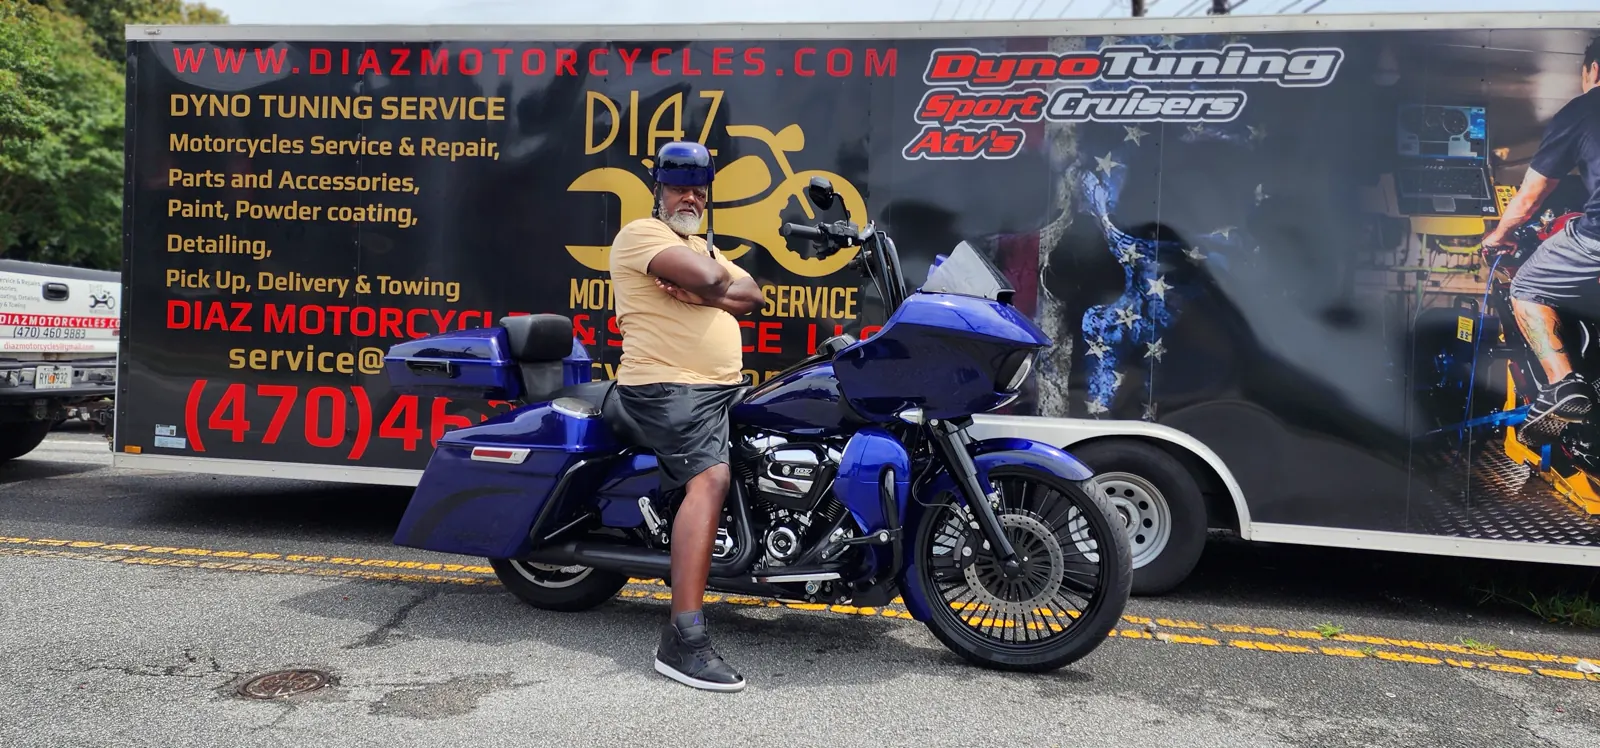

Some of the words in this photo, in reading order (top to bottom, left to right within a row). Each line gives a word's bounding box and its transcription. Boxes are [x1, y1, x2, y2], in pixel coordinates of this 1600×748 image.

[173, 47, 898, 77] WWW.DIAZMOTORCYCLES.COM
[170, 94, 251, 117] DYNO
[259, 95, 373, 119] TUNING
[381, 97, 505, 121] SERVICE
[921, 93, 1044, 122] Sport
[1050, 92, 1239, 116] Cruisers
[585, 90, 724, 157] DIAZ
[169, 133, 304, 158] Motorcycles
[310, 135, 393, 156] Service
[398, 136, 415, 156] &
[421, 137, 500, 161] Repair,
[910, 131, 1019, 154] Atv's
[168, 168, 225, 188] Parts
[231, 169, 273, 189] and
[278, 170, 420, 195] Accessories,
[168, 199, 229, 220] Paint,
[236, 200, 321, 221] Powder
[327, 203, 418, 228] coating,
[167, 234, 272, 260] Detailing,
[166, 269, 210, 289] Pick
[215, 270, 251, 294] Up,
[258, 272, 350, 298] Delivery
[355, 274, 372, 294] &
[377, 275, 460, 302] Towing
[760, 284, 858, 320] SERVICE
[13, 326, 40, 339] (470)
[43, 328, 62, 339] 460
[64, 329, 86, 339] 9883
[166, 299, 253, 333] DIAZ
[572, 313, 597, 346] &
[184, 378, 516, 461] (470)46
